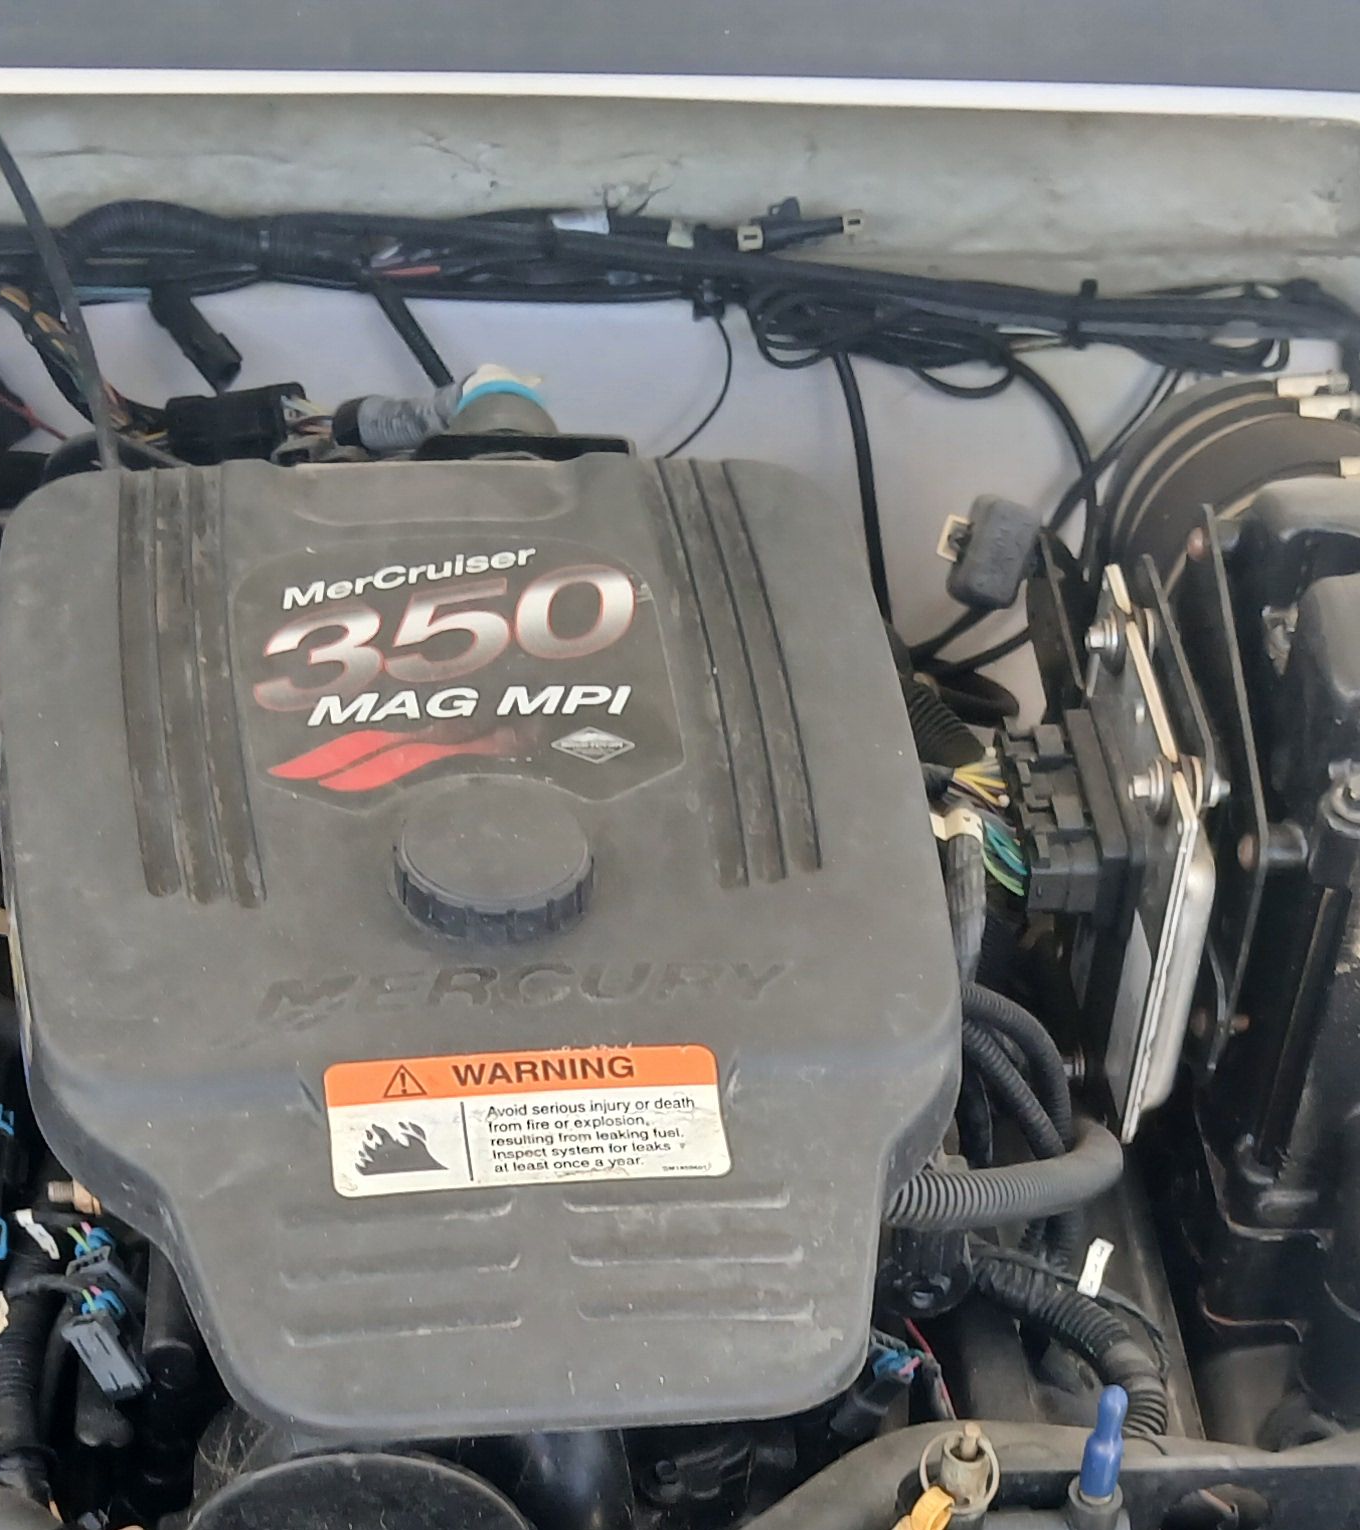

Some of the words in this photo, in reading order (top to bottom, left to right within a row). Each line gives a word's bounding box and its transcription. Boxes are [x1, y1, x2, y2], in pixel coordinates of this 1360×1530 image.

[283, 548, 536, 610] MerCruiser
[252, 563, 636, 712] 350
[307, 686, 478, 728] MAG
[496, 684, 633, 717] MPI
[255, 962, 792, 1026] MERCURY
[451, 1056, 635, 1087] WARNING
[487, 1106, 528, 1117] Avoid
[532, 1102, 586, 1116] serious
[590, 1099, 630, 1114] injury
[635, 1100, 649, 1110] or
[654, 1097, 695, 1109] death
[489, 1120, 522, 1133] from
[526, 1118, 550, 1131] fire
[554, 1119, 570, 1130] or
[491, 1133, 554, 1147] resulting
[558, 1131, 591, 1143] from
[596, 1129, 649, 1142] leaking
[653, 1128, 684, 1138] fuel.
[492, 1148, 547, 1160] Inspect
[551, 1145, 606, 1158] system
[609, 1143, 628, 1154] for
[632, 1141, 672, 1152] leaks
[494, 1162, 509, 1174] at
[513, 1159, 549, 1172] least
[553, 1158, 590, 1169] once
[607, 1156, 645, 1169] year.
